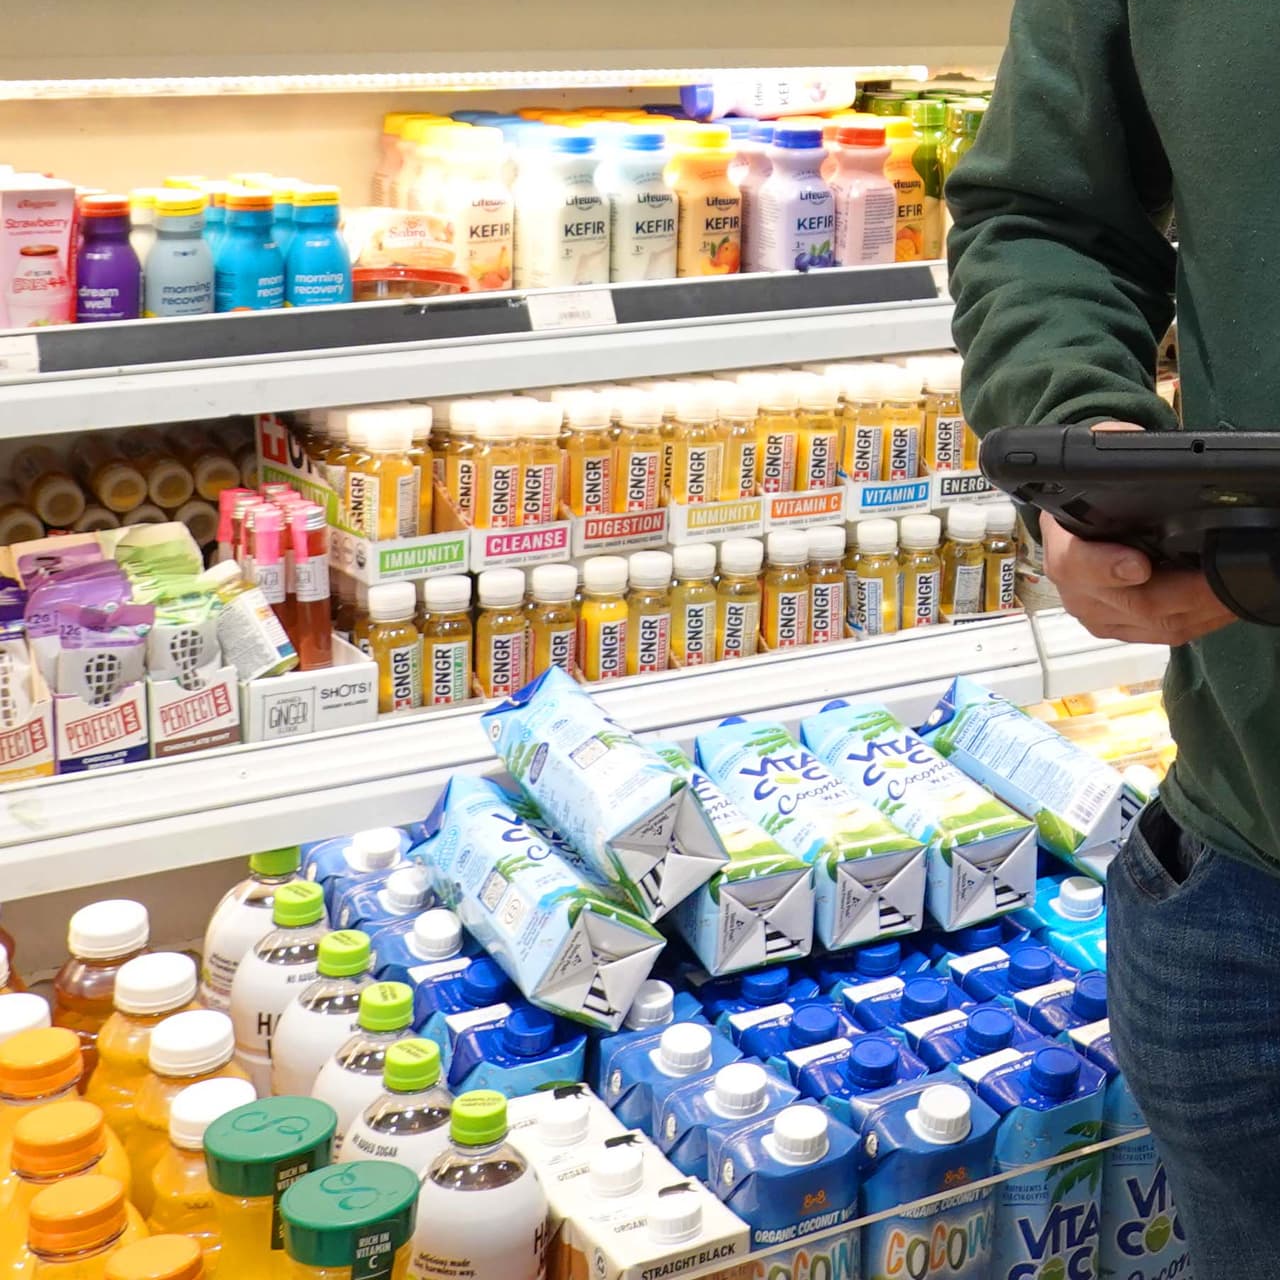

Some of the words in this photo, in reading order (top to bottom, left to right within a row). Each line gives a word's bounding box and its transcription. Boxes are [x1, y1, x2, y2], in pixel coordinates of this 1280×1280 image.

[469, 222, 511, 239] KEFIR
[564, 220, 606, 237] KEFIR
[635, 218, 675, 235] KEFIR
[704, 214, 740, 231] KEFIR
[796, 214, 835, 231] KEFIR
[162, 282, 212, 296] morning
[293, 283, 345, 295] recovery
[294, 272, 344, 284] morning
[78, 285, 120, 298] dream
[161, 293, 212, 306] recovery
[766, 434, 784, 478] GNGR
[855, 428, 873, 471] GNGR
[491, 467, 511, 515] GNGR
[523, 467, 544, 514] GNGR
[864, 485, 915, 506] VITAMIN
[917, 483, 927, 500] D
[690, 504, 758, 526] IMMUNITY
[774, 496, 828, 516] VITAMIN
[831, 496, 838, 511] C
[587, 513, 662, 538] DIGESTION
[489, 529, 564, 554] CLEANSE
[383, 543, 461, 570] IMMUNITY
[813, 585, 831, 631] GNGR
[917, 573, 934, 618] GNGR
[641, 618, 658, 666] GNGR
[434, 647, 452, 698] GNGR
[159, 691, 214, 734] PERFECT
[65, 712, 122, 752] PERFECT
[847, 734, 924, 763] VITA
[739, 751, 820, 778] VITA
[358, 1233, 379, 1248] RICH
[380, 1231, 390, 1243] IN
[754, 1222, 798, 1245] ORGANIC
[798, 1211, 841, 1237] COCONUT
[1016, 1200, 1099, 1261] VITA
[355, 1242, 392, 1259] VITAMIN
[368, 1255, 379, 1270] C
[640, 1255, 698, 1280] STRAIGHT
[698, 1242, 737, 1265] BLACK
